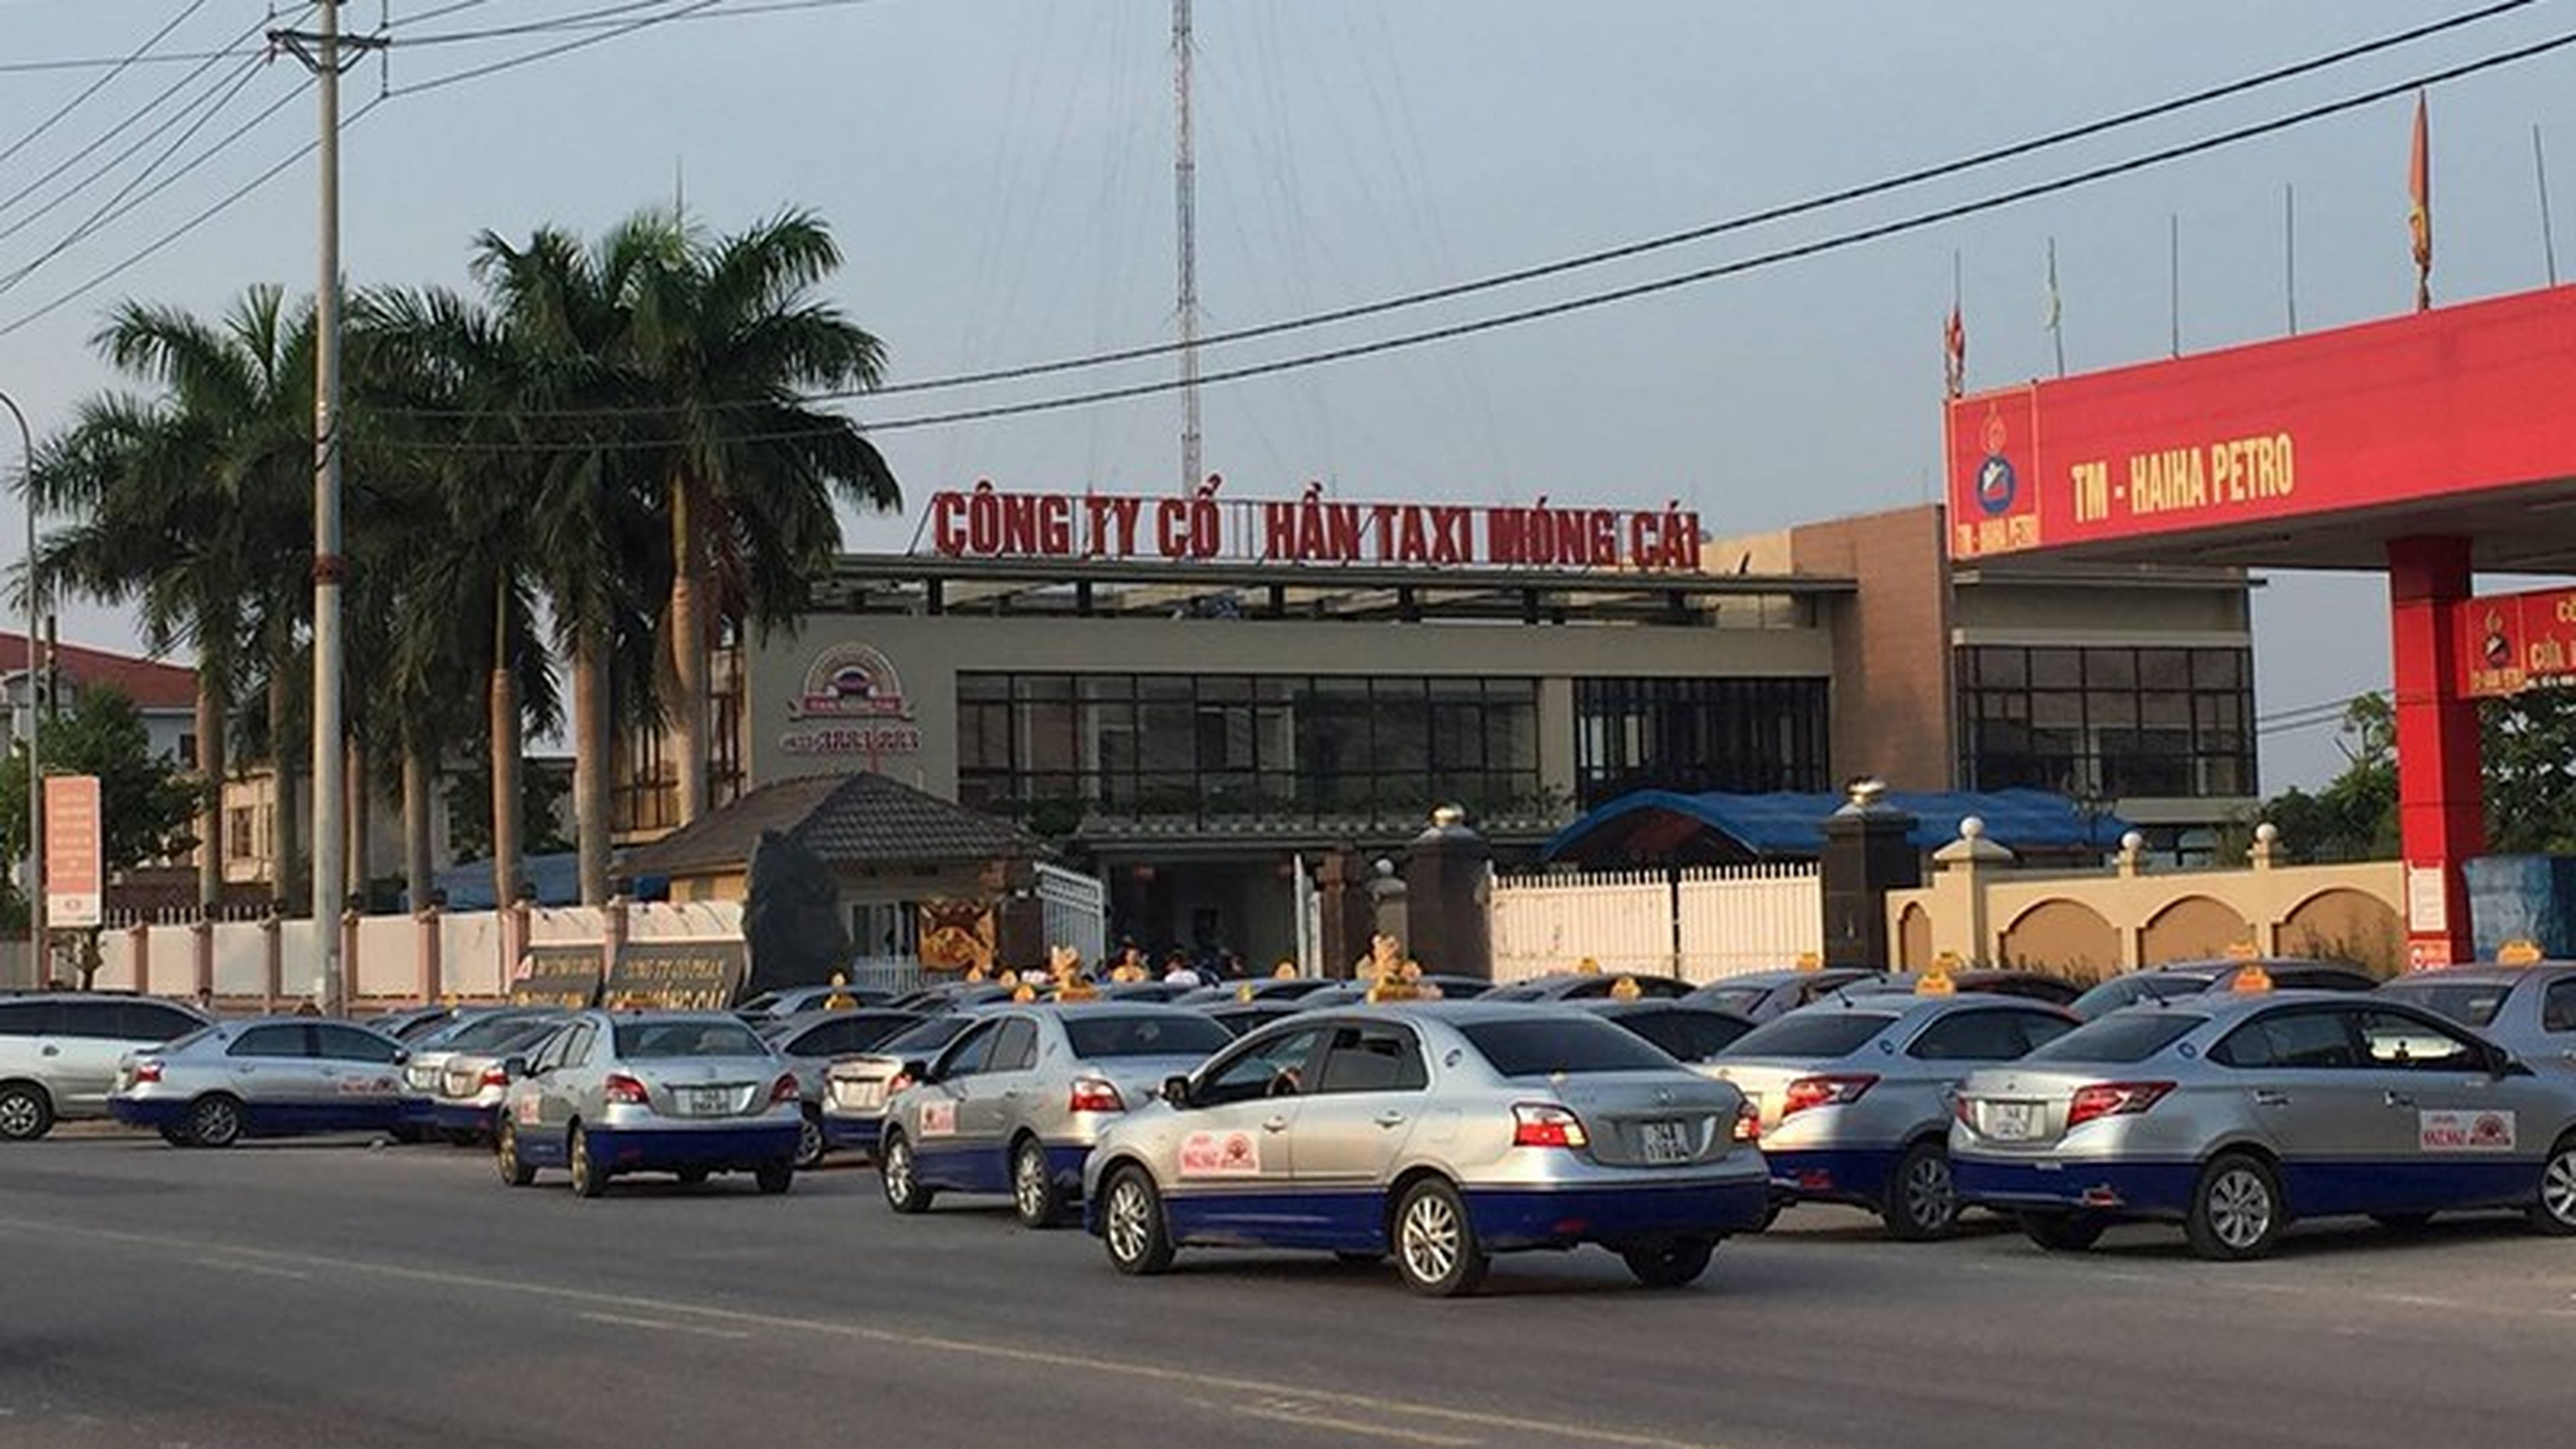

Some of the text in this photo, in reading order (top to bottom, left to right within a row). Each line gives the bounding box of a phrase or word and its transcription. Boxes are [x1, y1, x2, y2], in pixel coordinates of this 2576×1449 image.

[934, 480, 1071, 557] CÔNG
[1085, 495, 1140, 555] TY
[1157, 474, 1222, 557] CỔ
[1368, 505, 1472, 562] TAXI
[1487, 497, 1617, 566] MÓNG
[1630, 500, 1701, 569] CÁI
[2072, 462, 2108, 522] TM
[2131, 447, 2206, 514] HAIHA
[2212, 433, 2292, 503] PETRO
